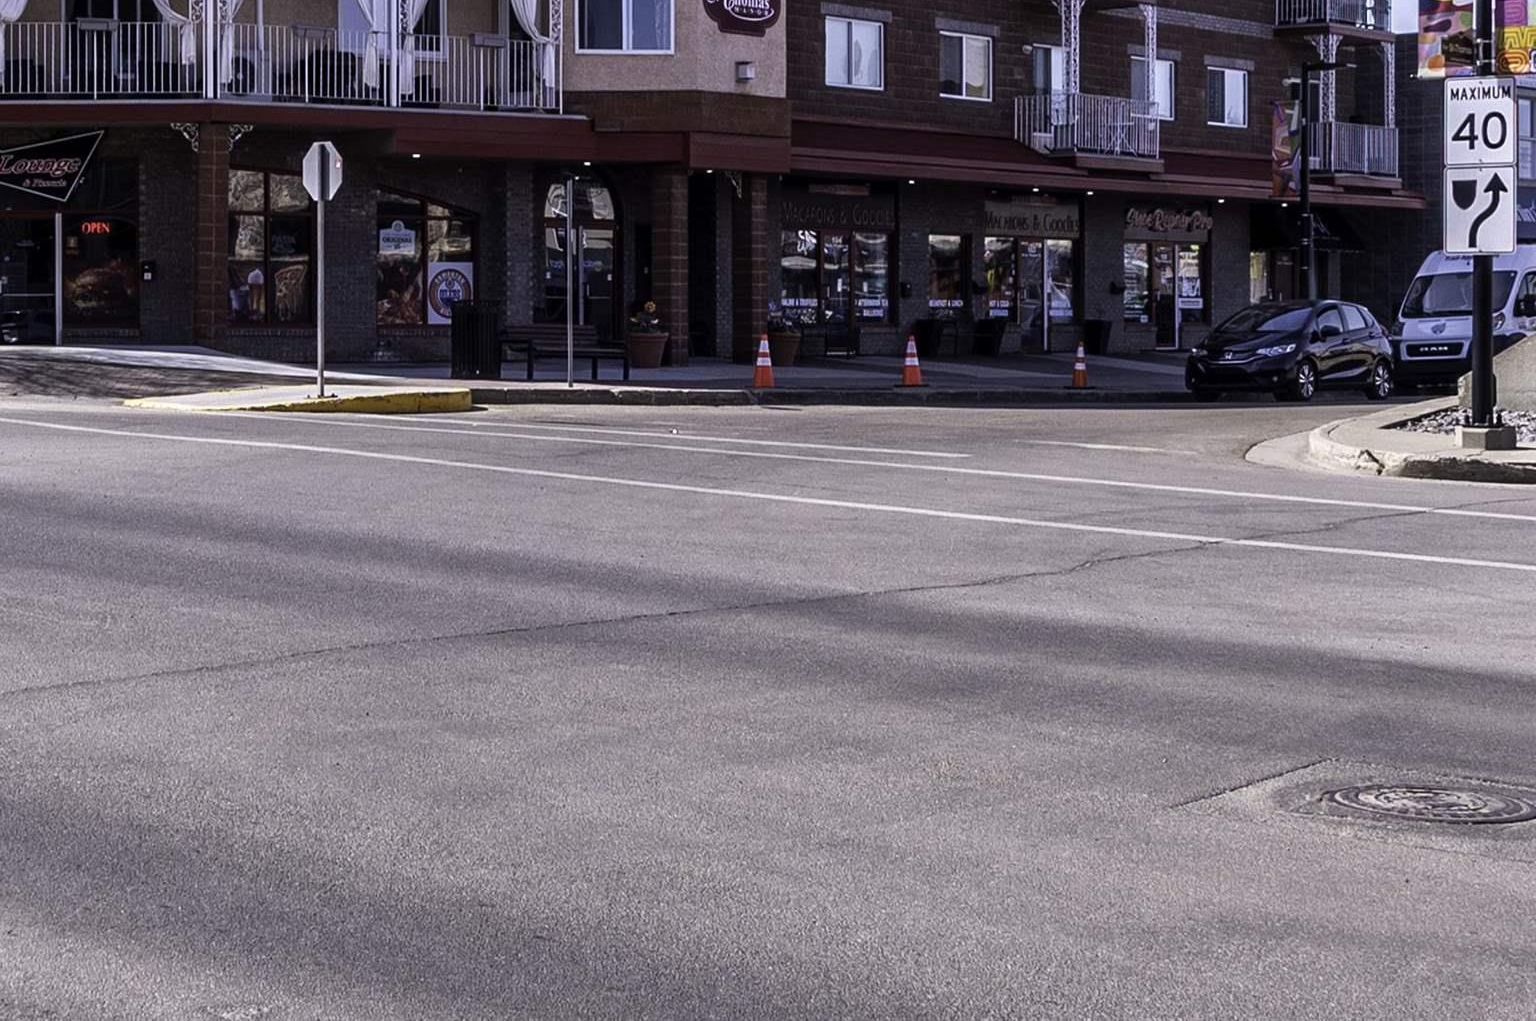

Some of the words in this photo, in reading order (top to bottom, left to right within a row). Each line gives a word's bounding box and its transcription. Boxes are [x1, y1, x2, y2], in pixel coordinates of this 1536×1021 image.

[1449, 86, 1512, 102] MAXIMUM
[1451, 111, 1508, 150] 40
[81, 222, 110, 234] OPEN
